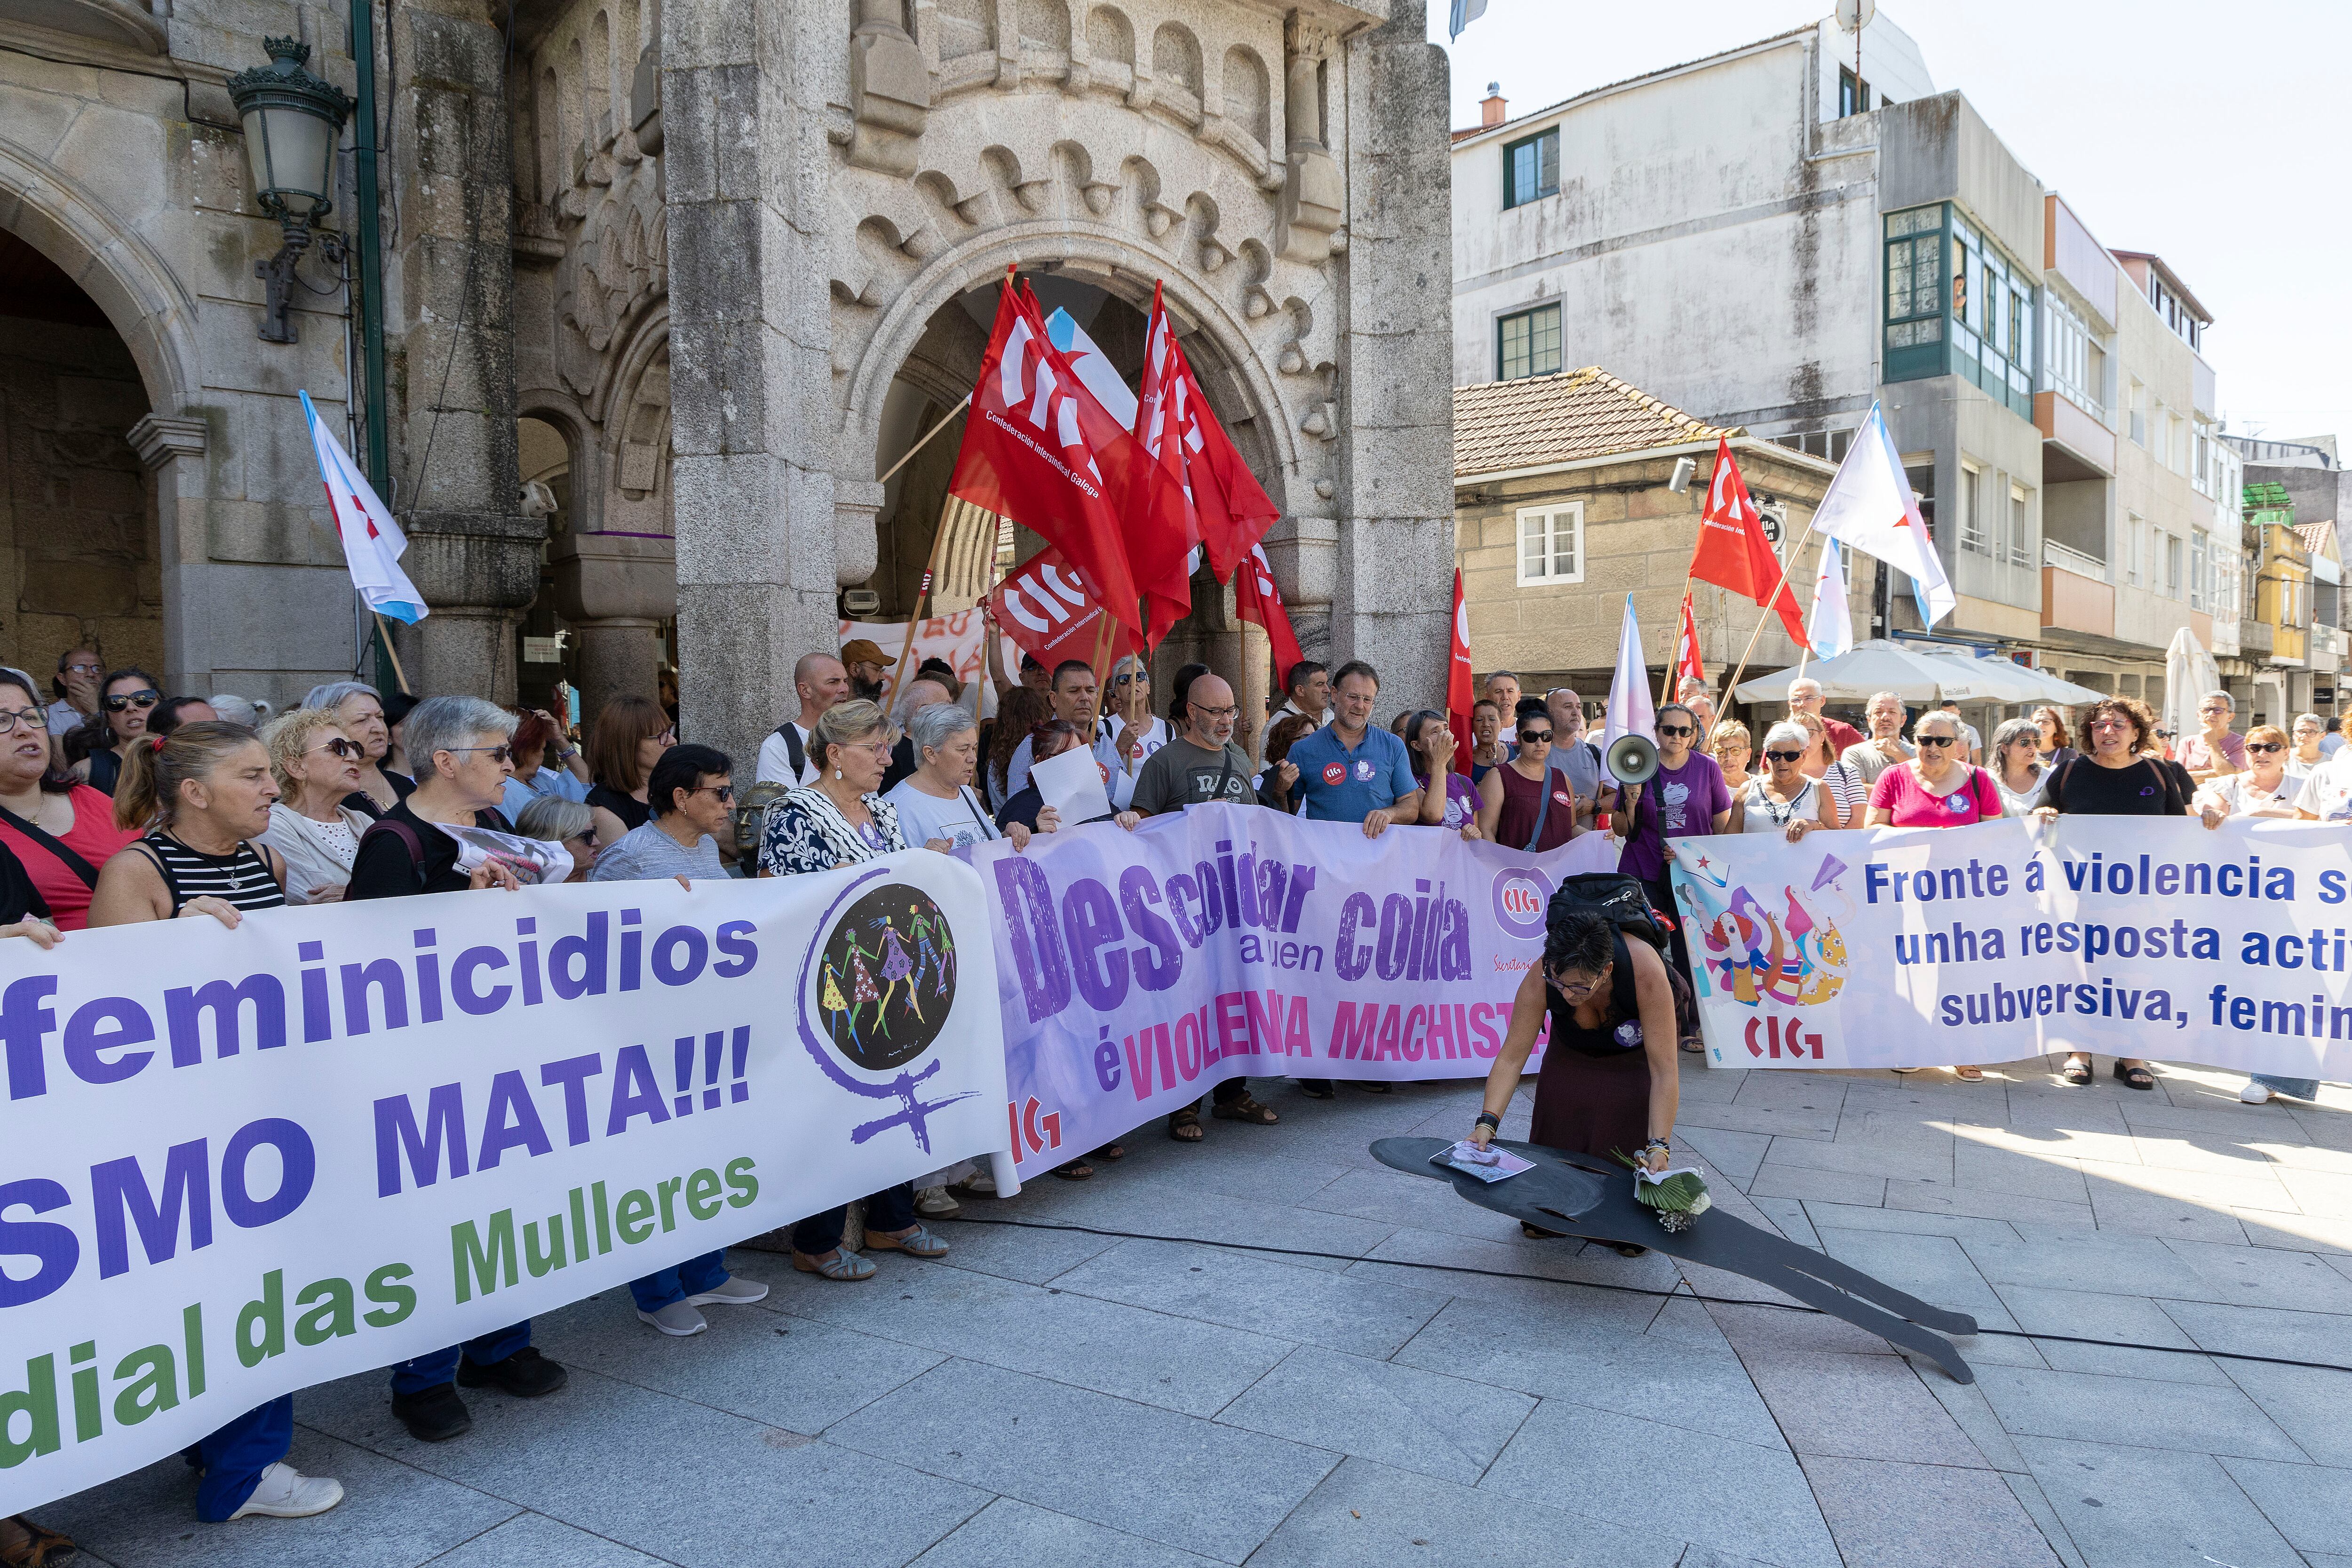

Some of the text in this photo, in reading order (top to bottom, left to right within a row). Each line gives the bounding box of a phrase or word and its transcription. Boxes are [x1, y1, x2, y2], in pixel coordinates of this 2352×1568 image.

[986, 410, 1099, 499] Confederación Intersindical Galega
[1044, 626, 1076, 650] Confederación
[1075, 611, 1099, 629] Intersindical
[1327, 767, 1342, 778] CIG
[1504, 888, 1540, 913] CIG
[1865, 858, 2009, 904] Fronte
[2025, 851, 2046, 893] á
[2063, 852, 2296, 901] violencia
[1895, 921, 2004, 965] unha
[2020, 918, 2221, 963] resposta
[0, 907, 758, 1101] feminicidios
[1941, 977, 2352, 1041] subversiva, femin
[1094, 1024, 1120, 1092] é
[1745, 1016, 1824, 1059] CIG
[373, 1025, 751, 1199] MATA!!!
[0, 1156, 759, 1468] dial das Mulleres
